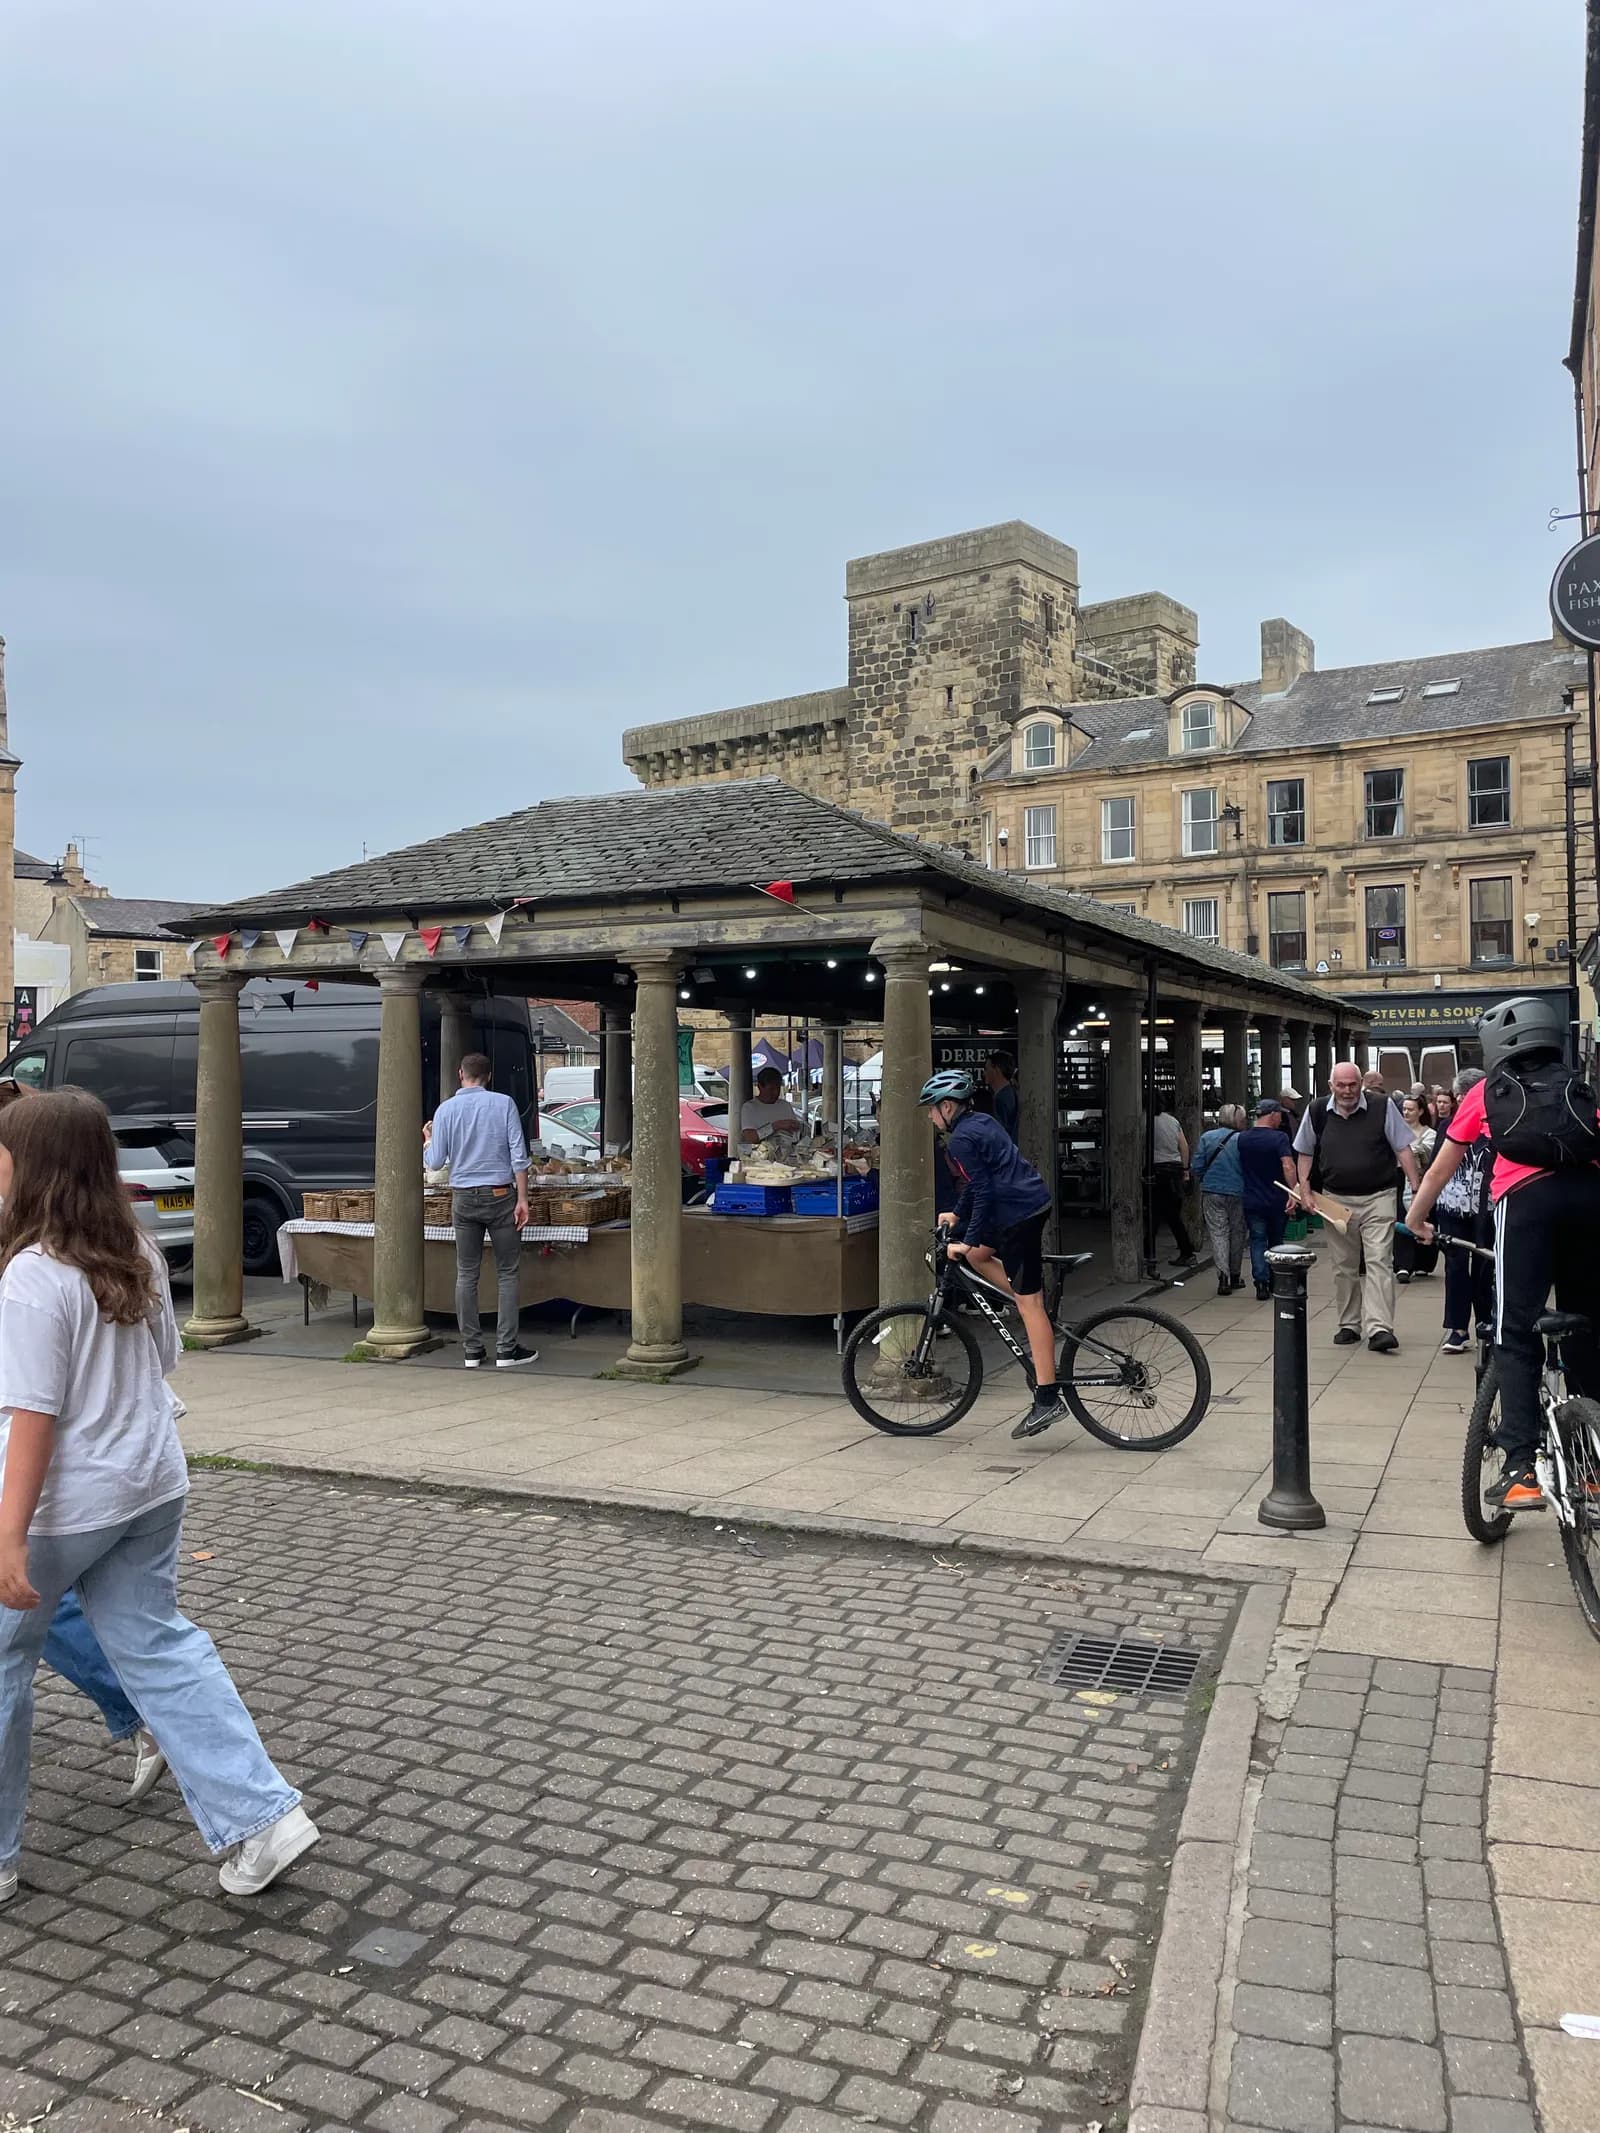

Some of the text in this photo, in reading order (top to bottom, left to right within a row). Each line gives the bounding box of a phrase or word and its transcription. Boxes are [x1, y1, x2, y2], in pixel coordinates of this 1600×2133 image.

[1371, 1006, 1484, 1020] STEVEN & SONS
